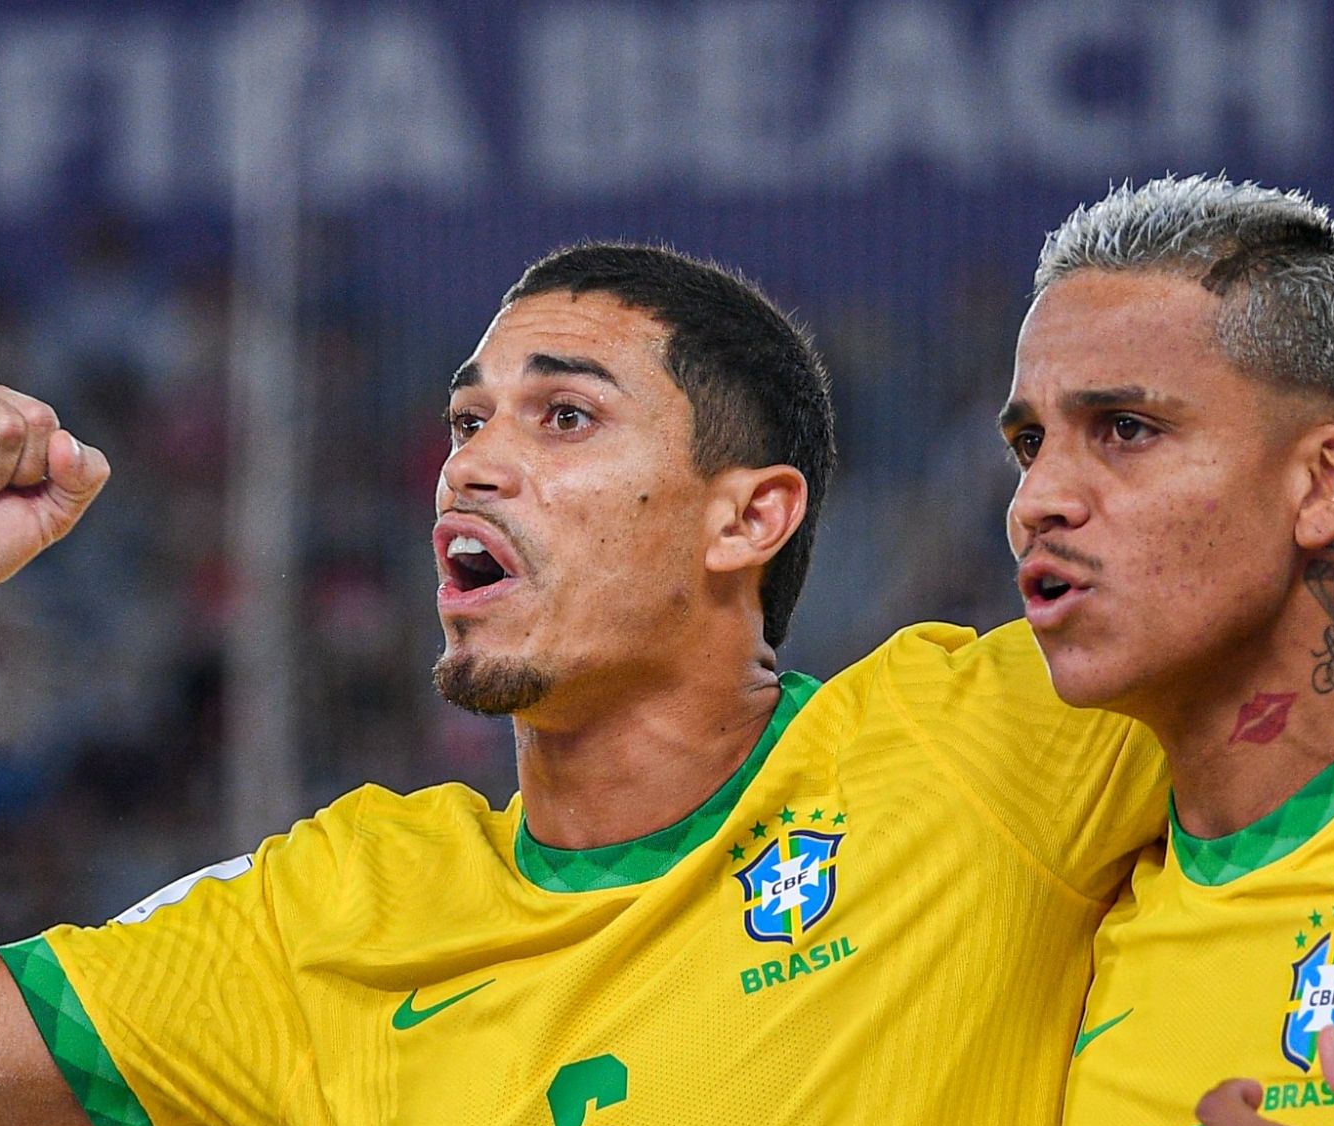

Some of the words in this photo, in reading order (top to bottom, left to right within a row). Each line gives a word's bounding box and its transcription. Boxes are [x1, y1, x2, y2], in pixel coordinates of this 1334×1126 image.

[522, 0, 1325, 188] BEACH
[771, 870, 809, 896] CBF
[739, 936, 859, 995] BRASIL
